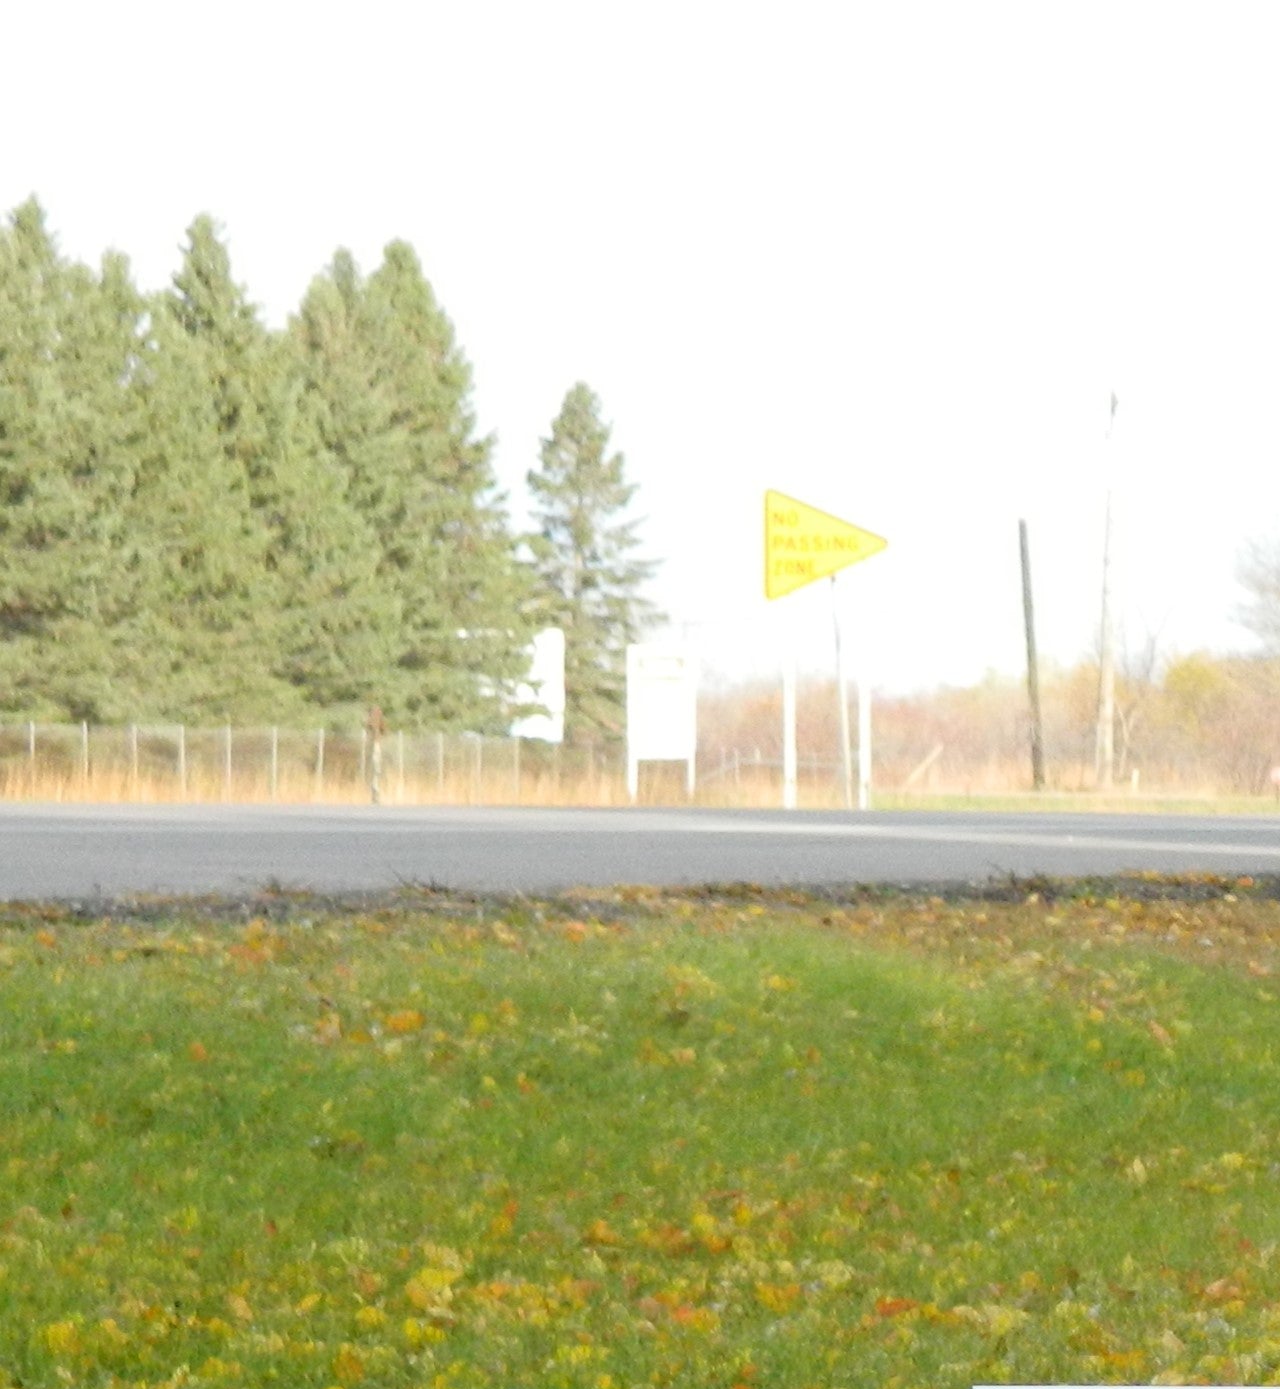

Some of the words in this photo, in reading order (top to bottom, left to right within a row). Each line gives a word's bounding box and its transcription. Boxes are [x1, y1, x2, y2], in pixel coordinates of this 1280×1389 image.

[772, 510, 799, 528] NO
[772, 534, 859, 552] PASSING
[774, 558, 815, 577] ZONE
